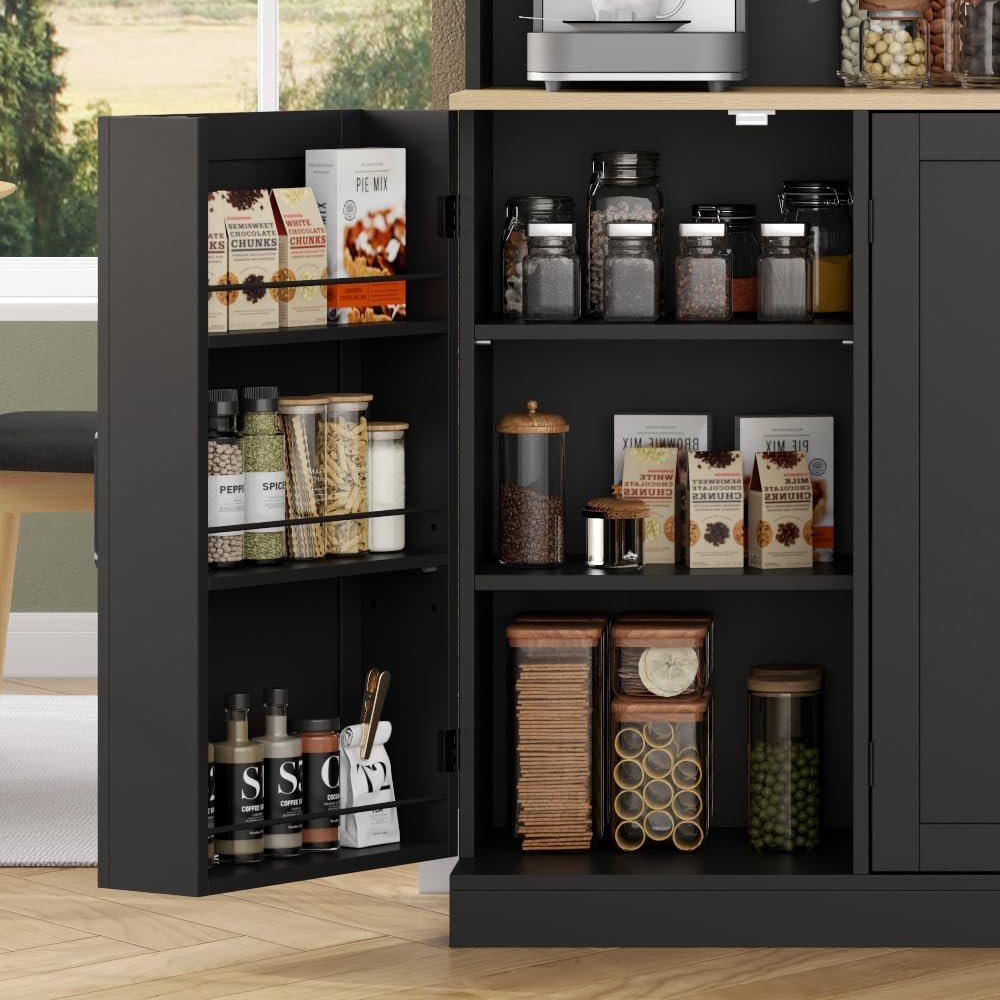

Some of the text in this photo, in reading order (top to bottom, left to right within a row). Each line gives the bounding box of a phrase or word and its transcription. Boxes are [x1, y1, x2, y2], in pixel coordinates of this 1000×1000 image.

[356, 176, 388, 193] PIE MIX
[228, 222, 274, 230] SEMISWEET
[285, 219, 311, 227] WHITE
[229, 230, 277, 238] CHOCOLATE
[230, 238, 278, 248] CHUNKS
[289, 235, 327, 246] CHUNKS
